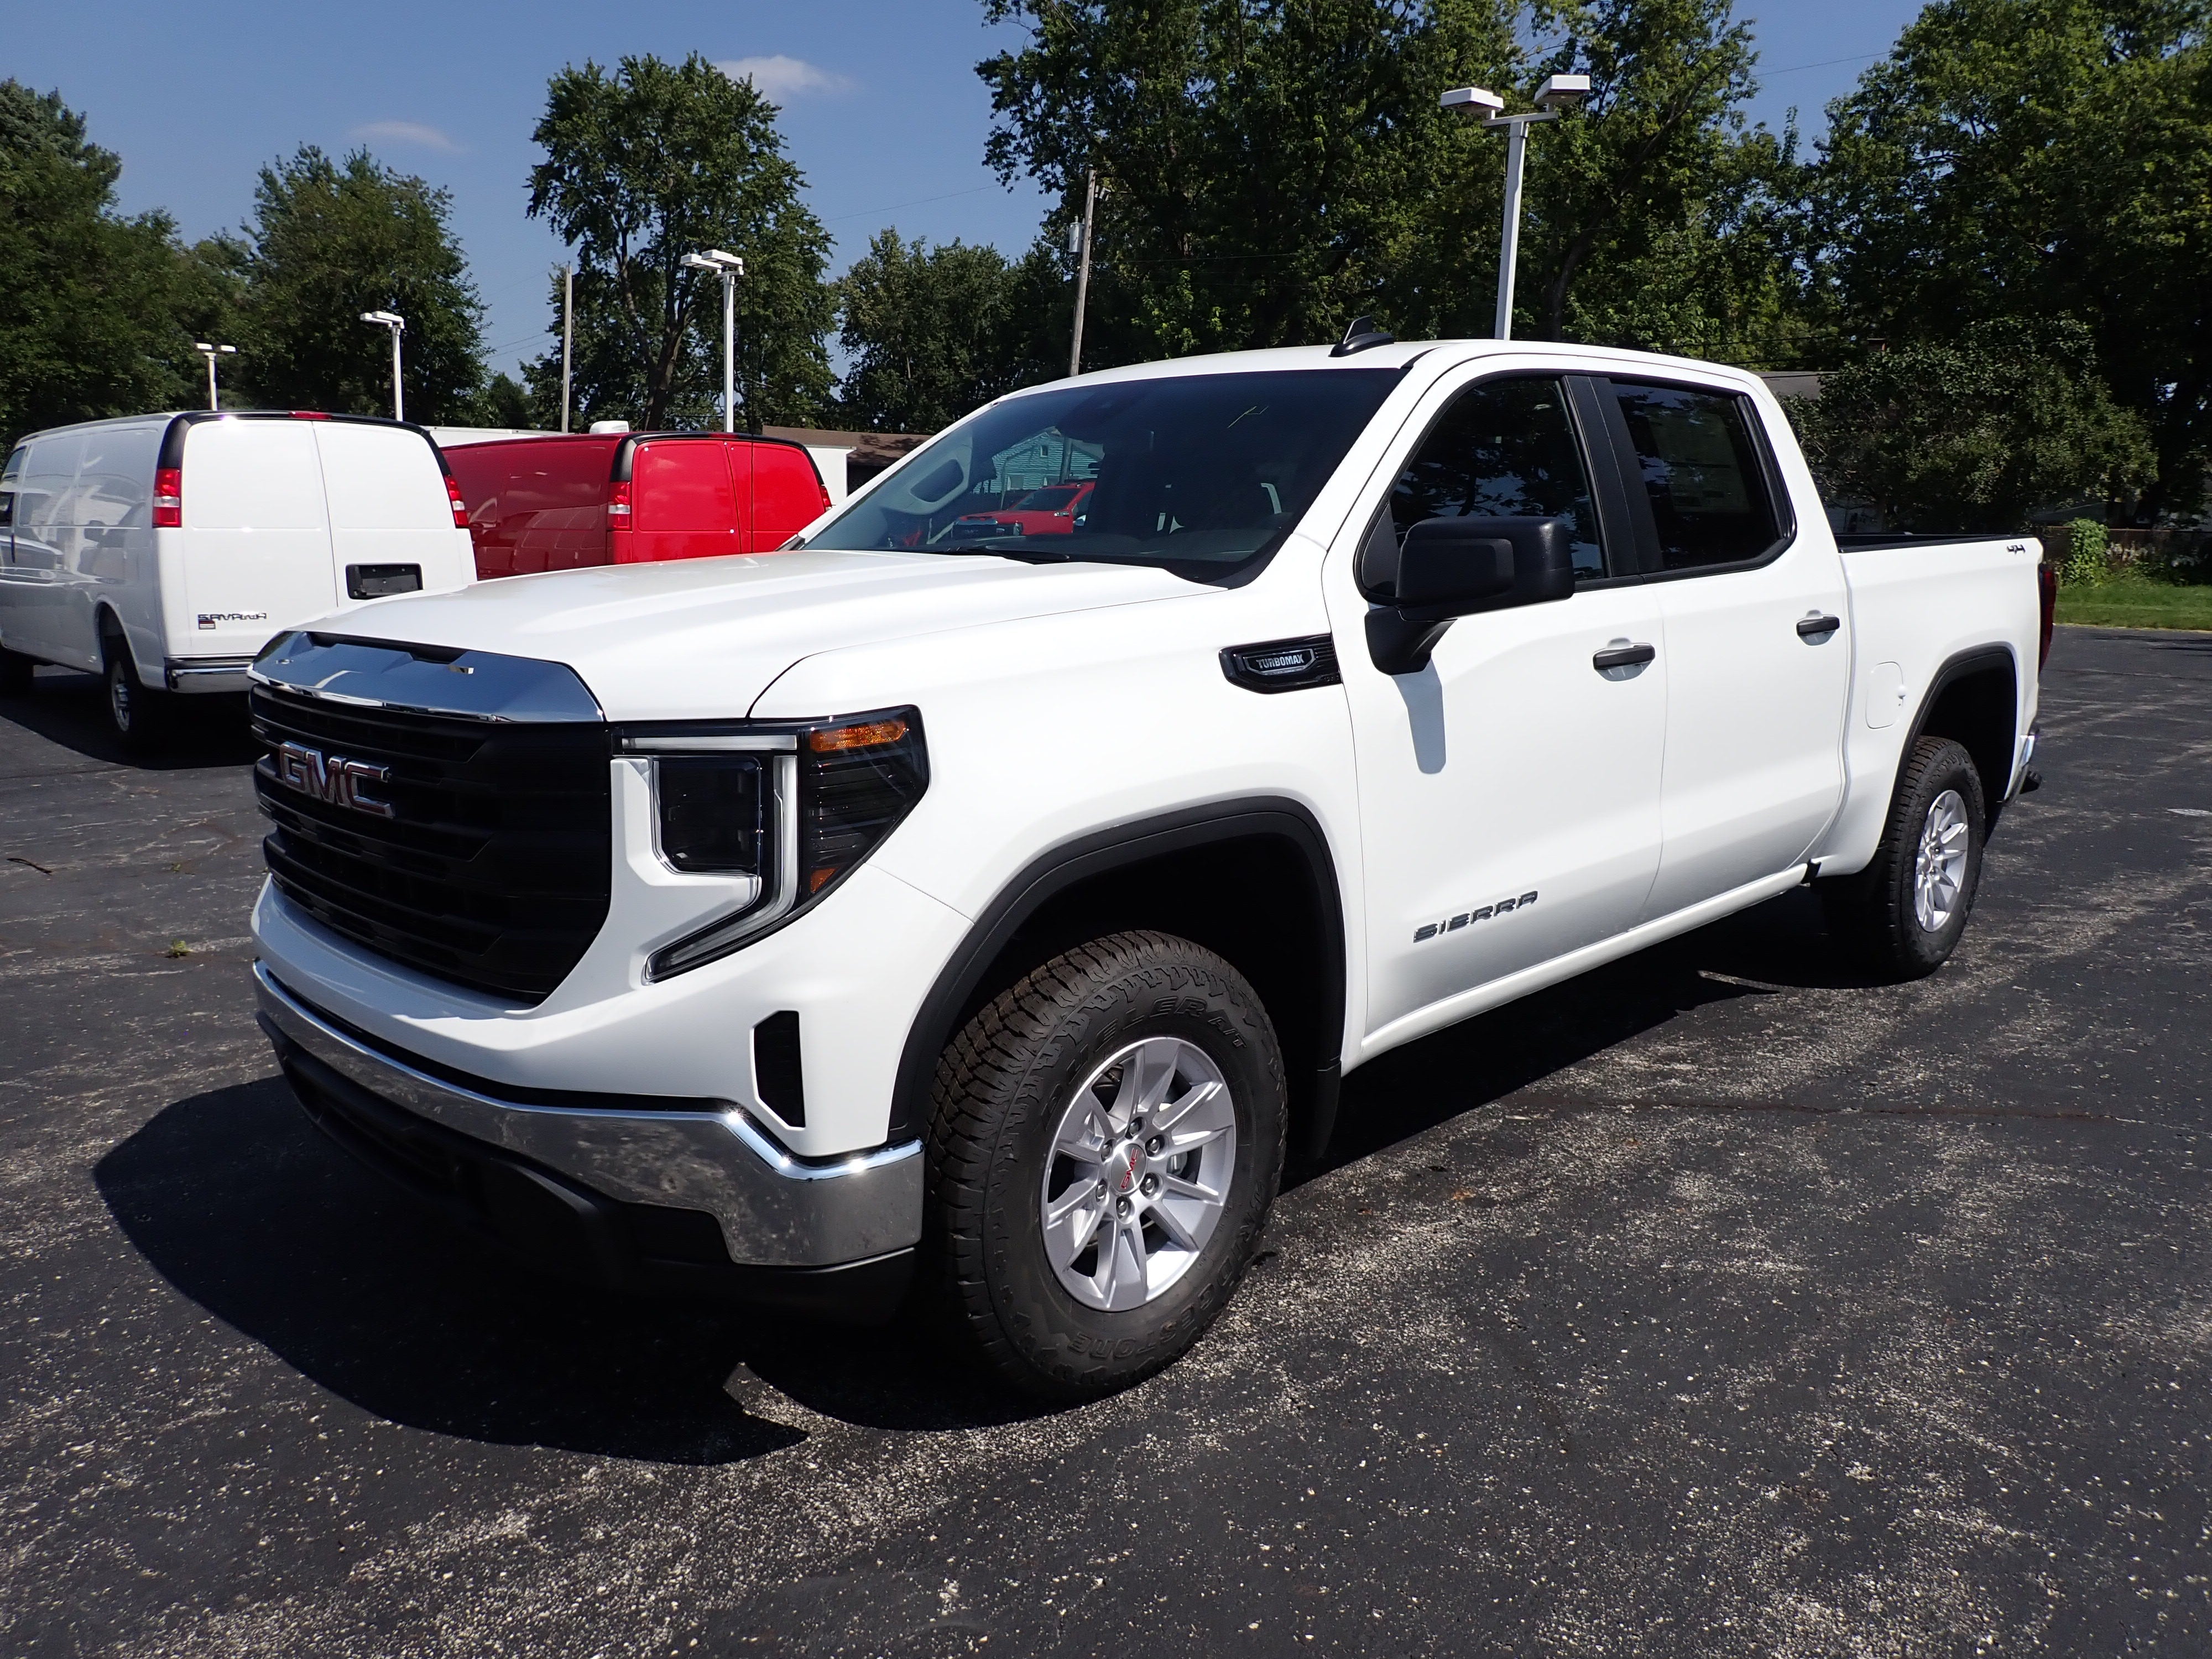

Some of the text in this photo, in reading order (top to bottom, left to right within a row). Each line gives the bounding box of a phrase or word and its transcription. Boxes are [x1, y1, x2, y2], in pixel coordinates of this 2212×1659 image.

[1256, 654, 1304, 669] TURBOMAX
[279, 740, 394, 819] GMC
[1413, 890, 1538, 943] SIERRA
[1120, 1147, 1139, 1190] GMC
